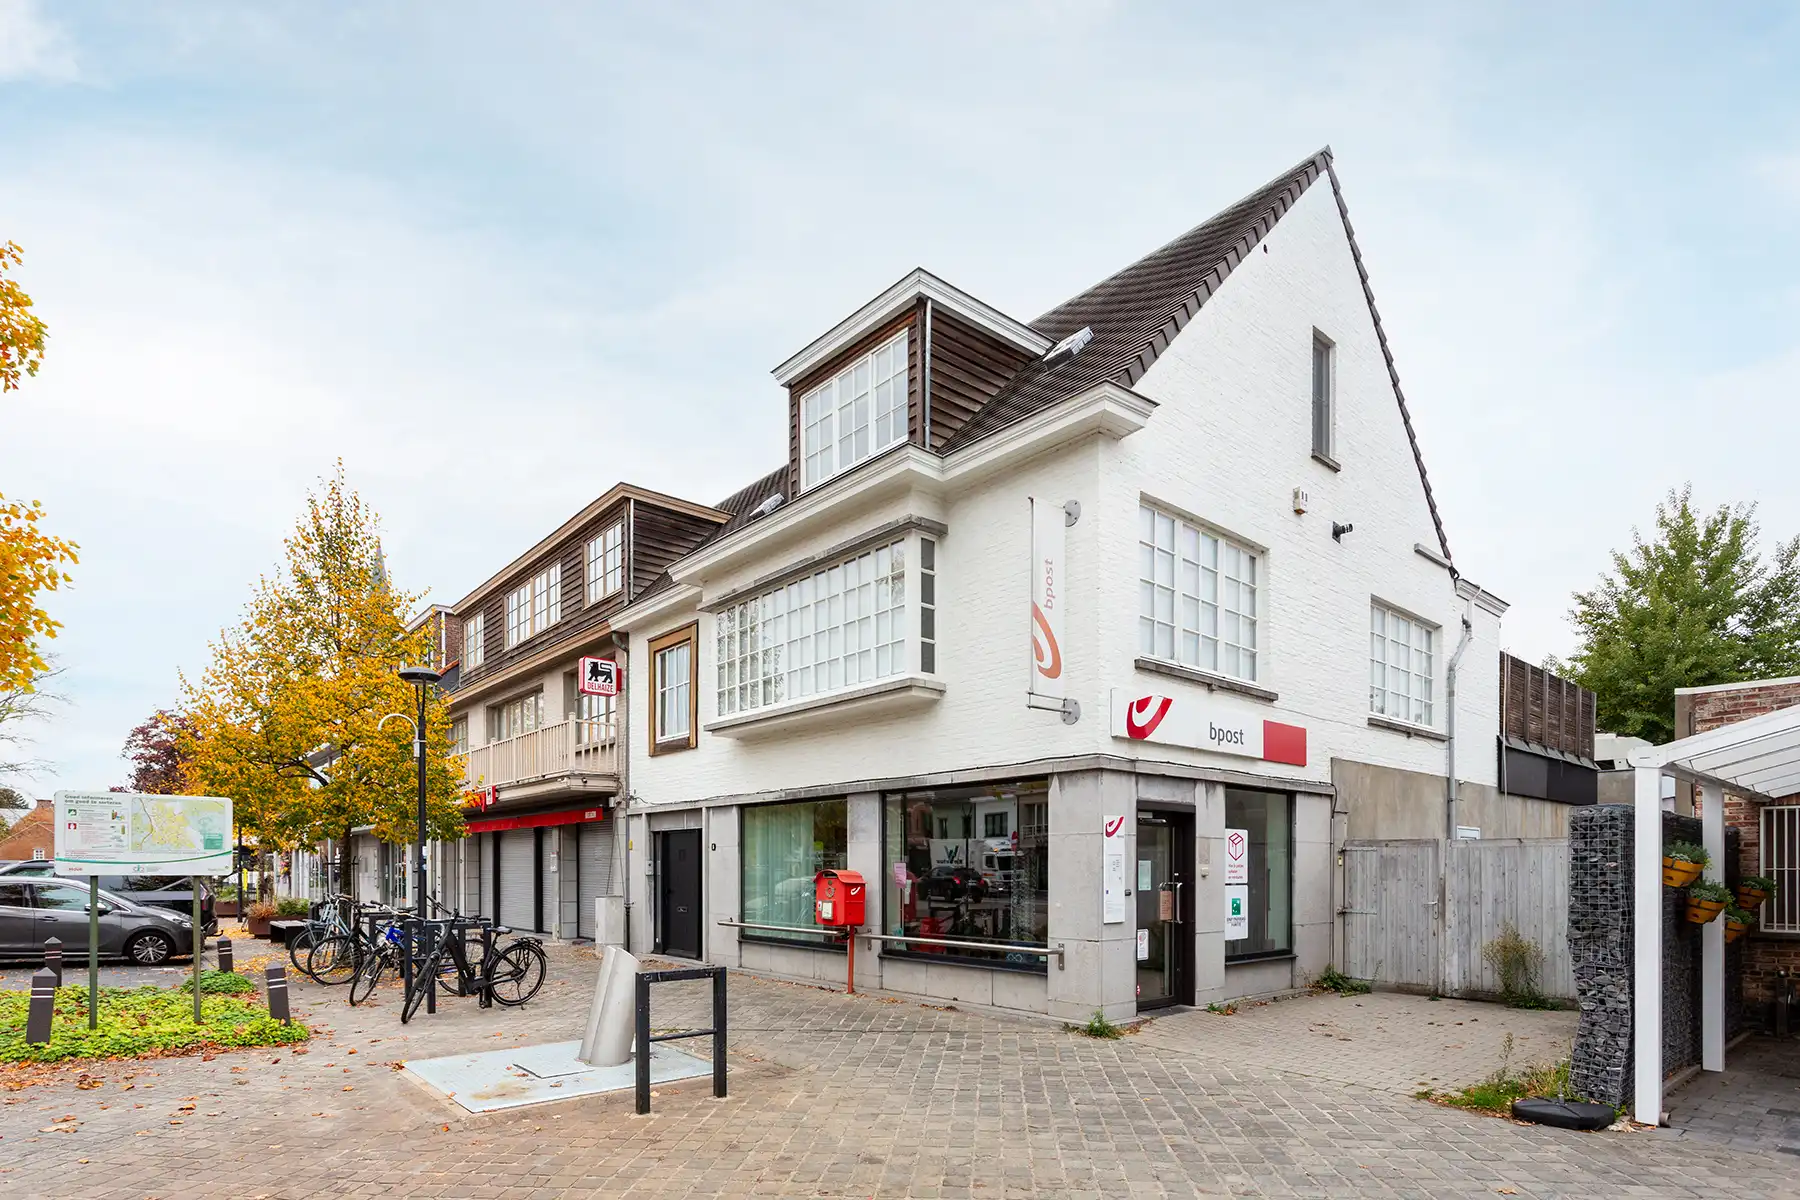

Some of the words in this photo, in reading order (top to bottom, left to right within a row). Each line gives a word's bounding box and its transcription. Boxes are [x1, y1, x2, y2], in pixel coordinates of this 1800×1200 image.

[1044, 558, 1056, 610] bpost
[587, 681, 614, 692] DELHAIZE
[1209, 721, 1244, 746] bpost
